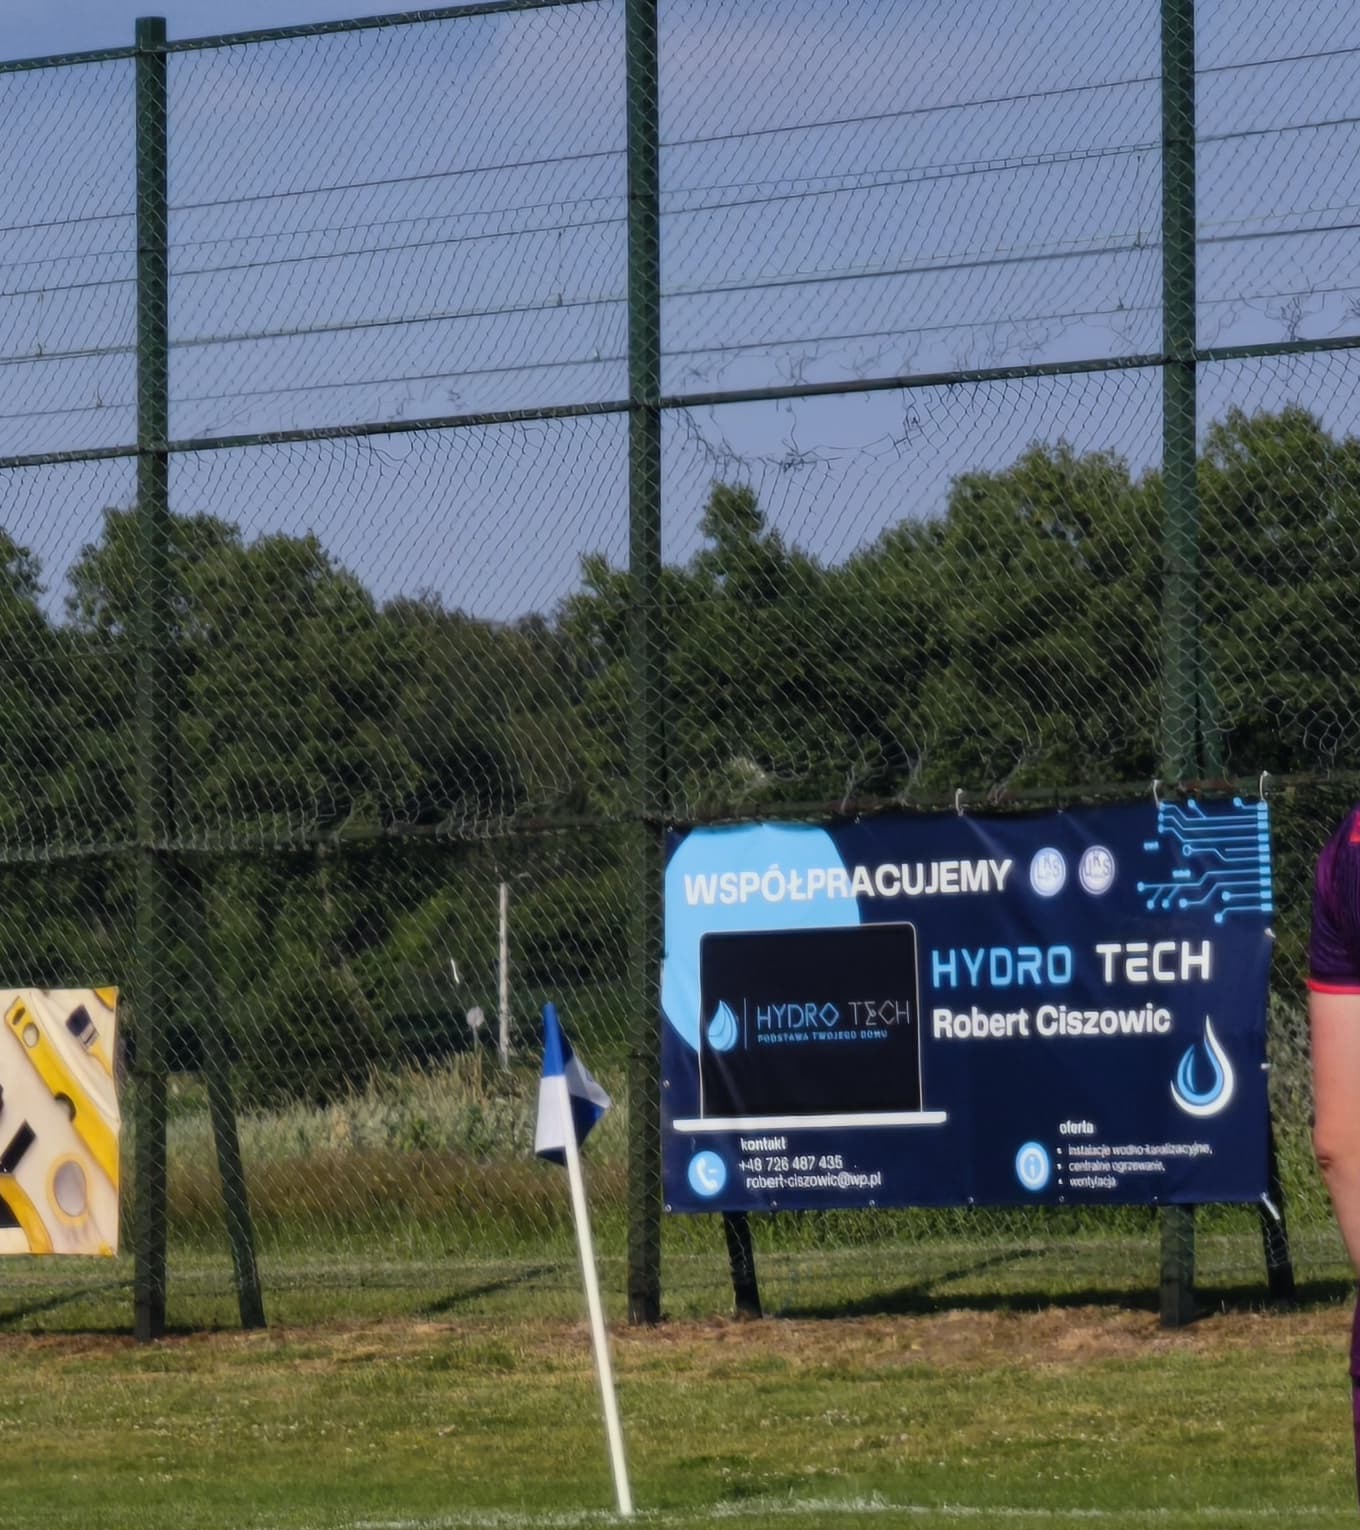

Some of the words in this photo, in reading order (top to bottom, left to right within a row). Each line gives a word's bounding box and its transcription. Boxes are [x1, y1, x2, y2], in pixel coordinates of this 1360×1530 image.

[683, 859, 1013, 906] WSPÓŁPRACUJEMY
[931, 945, 1072, 988] HYDRO
[1095, 940, 1211, 983] TECH
[756, 1002, 840, 1031] HYDRO
[847, 1000, 911, 1026] TECH
[932, 1006, 1029, 1039] Robert
[1036, 1002, 1172, 1037] Ciszowic
[740, 1136, 787, 1151] kontakt
